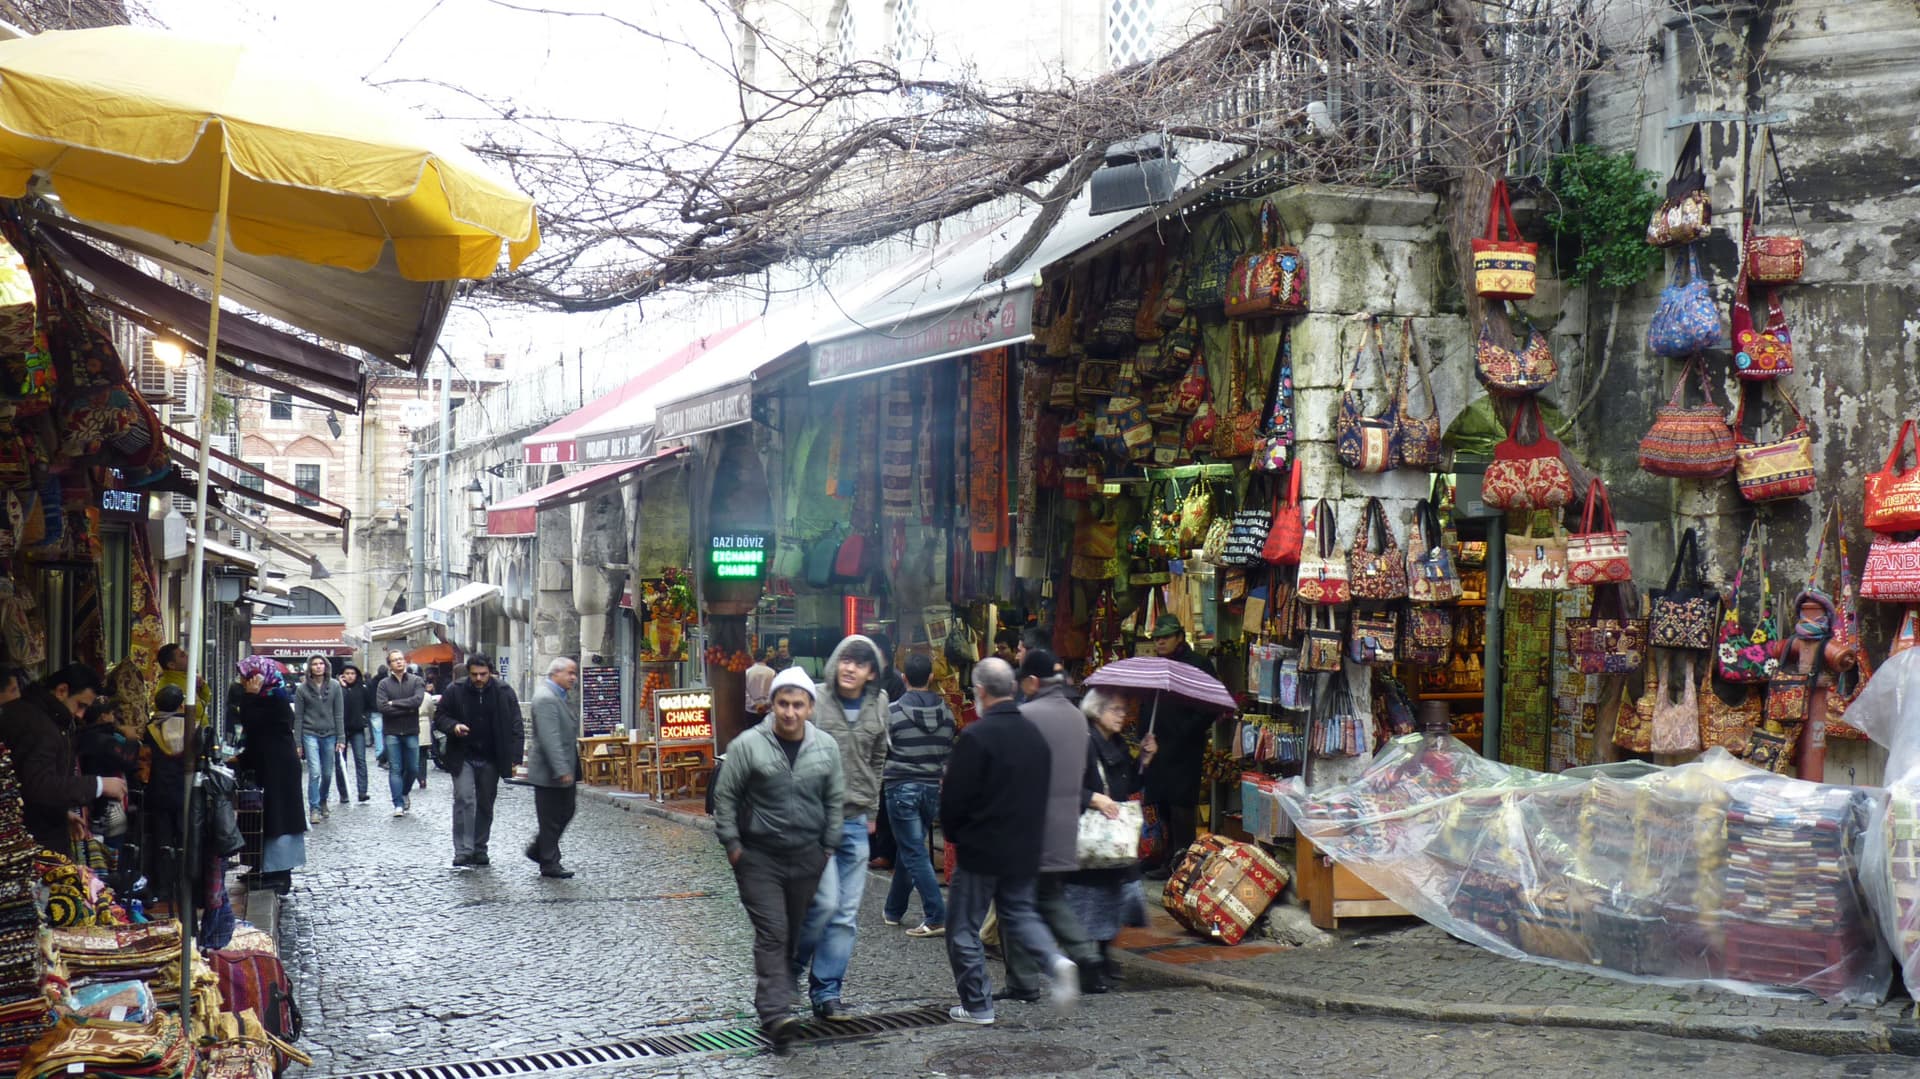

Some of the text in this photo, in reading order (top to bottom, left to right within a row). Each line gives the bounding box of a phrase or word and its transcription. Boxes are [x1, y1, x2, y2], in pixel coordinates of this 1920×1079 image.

[102, 490, 142, 512] GOURMET
[712, 550, 764, 563] EXCHANGE
[717, 563, 757, 577] CHANGE
[666, 710, 705, 724] CHANGE
[661, 724, 711, 738] EXCHANGE
